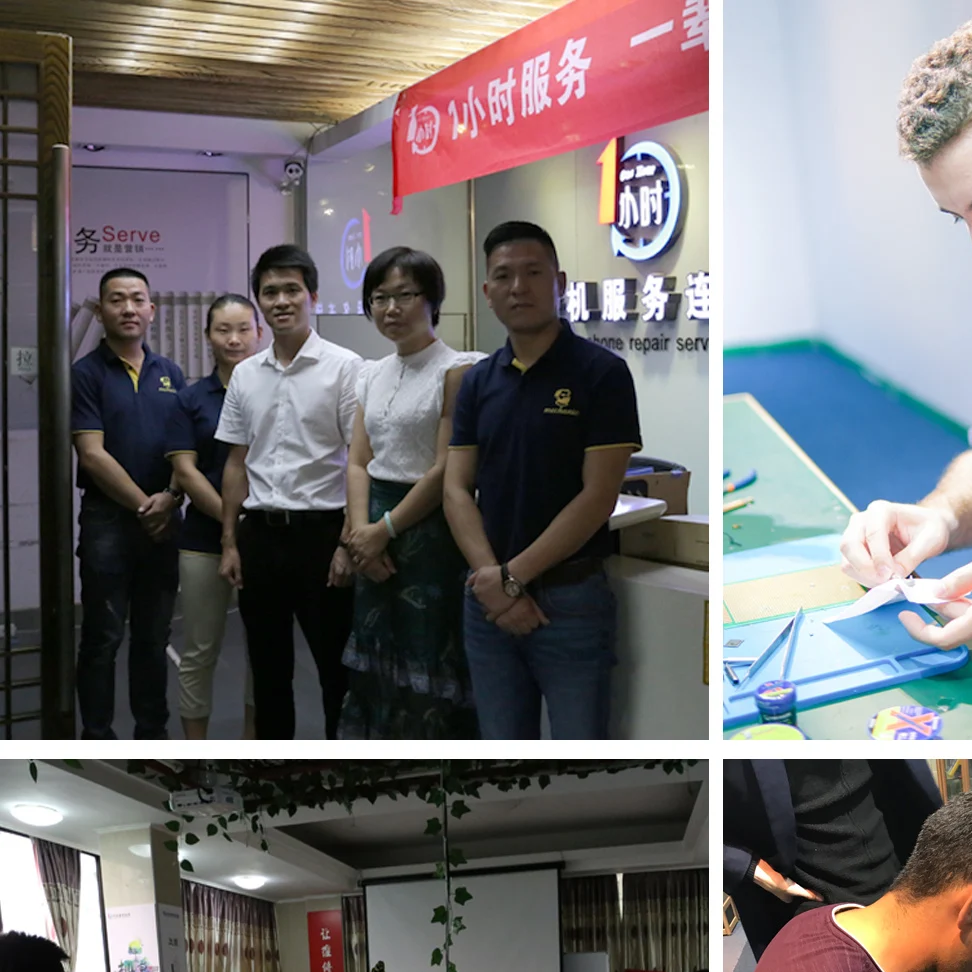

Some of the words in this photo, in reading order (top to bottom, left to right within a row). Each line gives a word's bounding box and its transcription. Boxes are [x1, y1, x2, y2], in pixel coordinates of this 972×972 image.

[447, 37, 593, 141] 1小时服务
[74, 227, 100, 254] 务
[102, 225, 161, 243] Serve
[566, 270, 709, 322] 机服务连
[588, 334, 623, 350] hone
[629, 334, 671, 354] repair
[676, 337, 709, 351] serv
